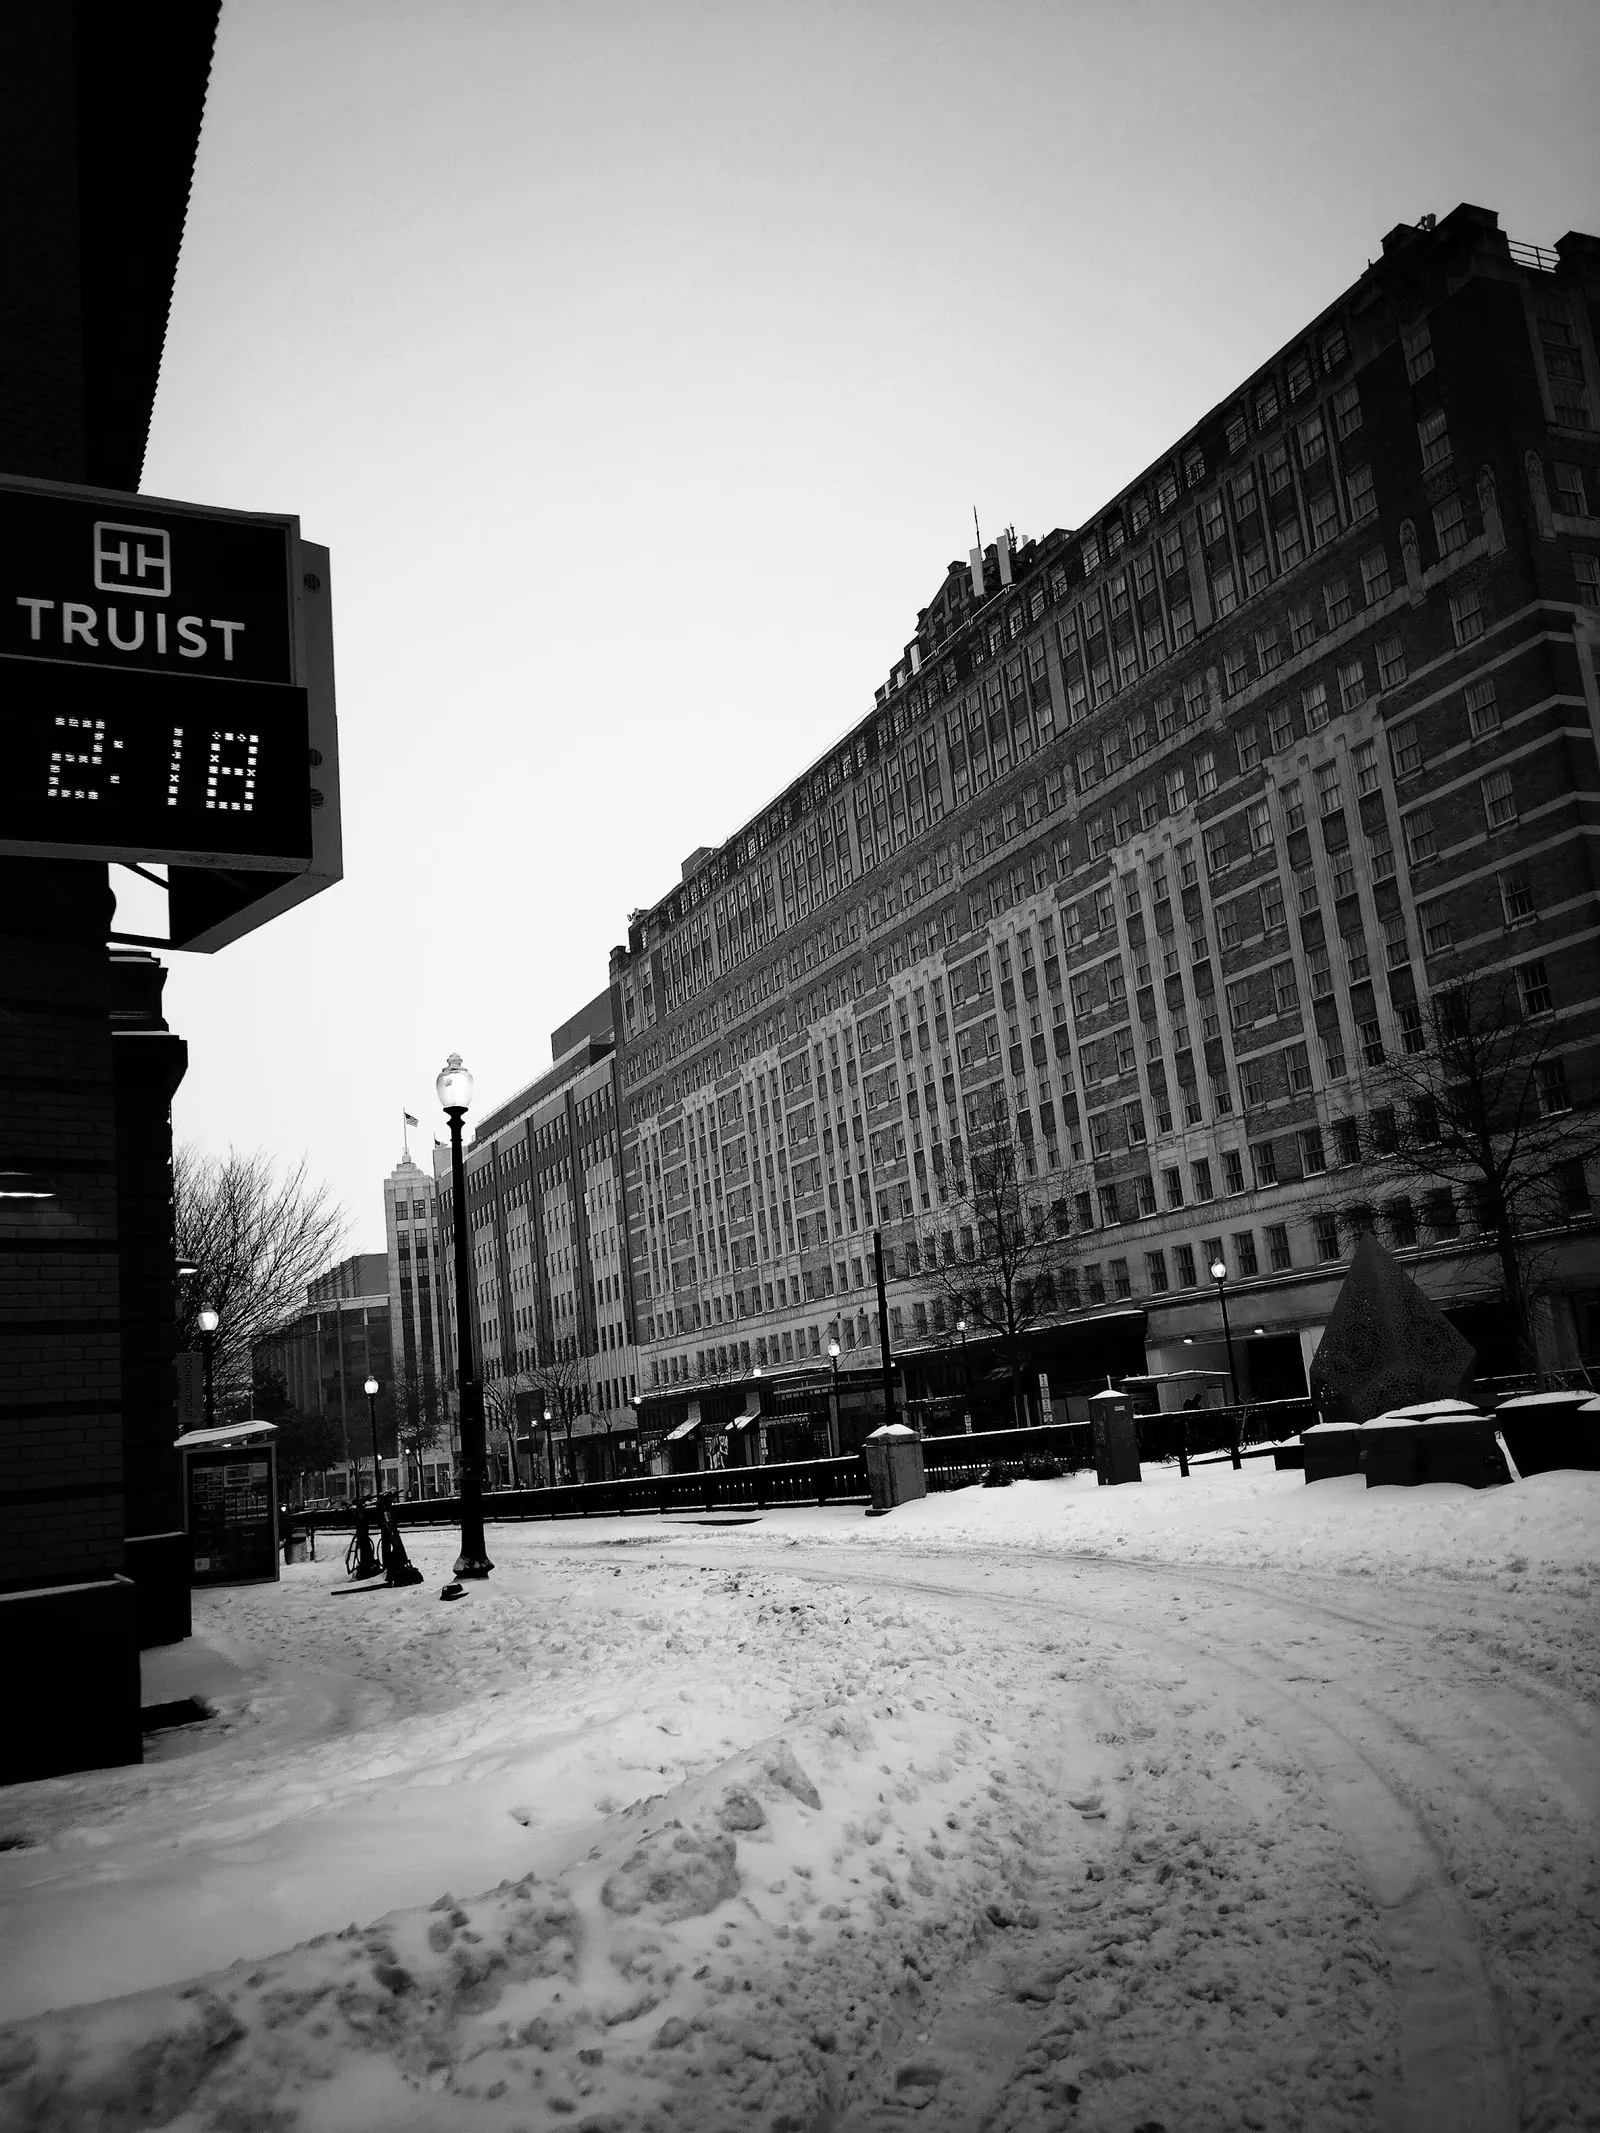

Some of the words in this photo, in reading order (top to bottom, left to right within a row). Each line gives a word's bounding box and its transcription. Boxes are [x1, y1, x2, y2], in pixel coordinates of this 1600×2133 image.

[16, 597, 246, 661] TRUIST
[47, 716, 260, 812] 2:18
[184, 1357, 193, 1417] CONNECTICUT
